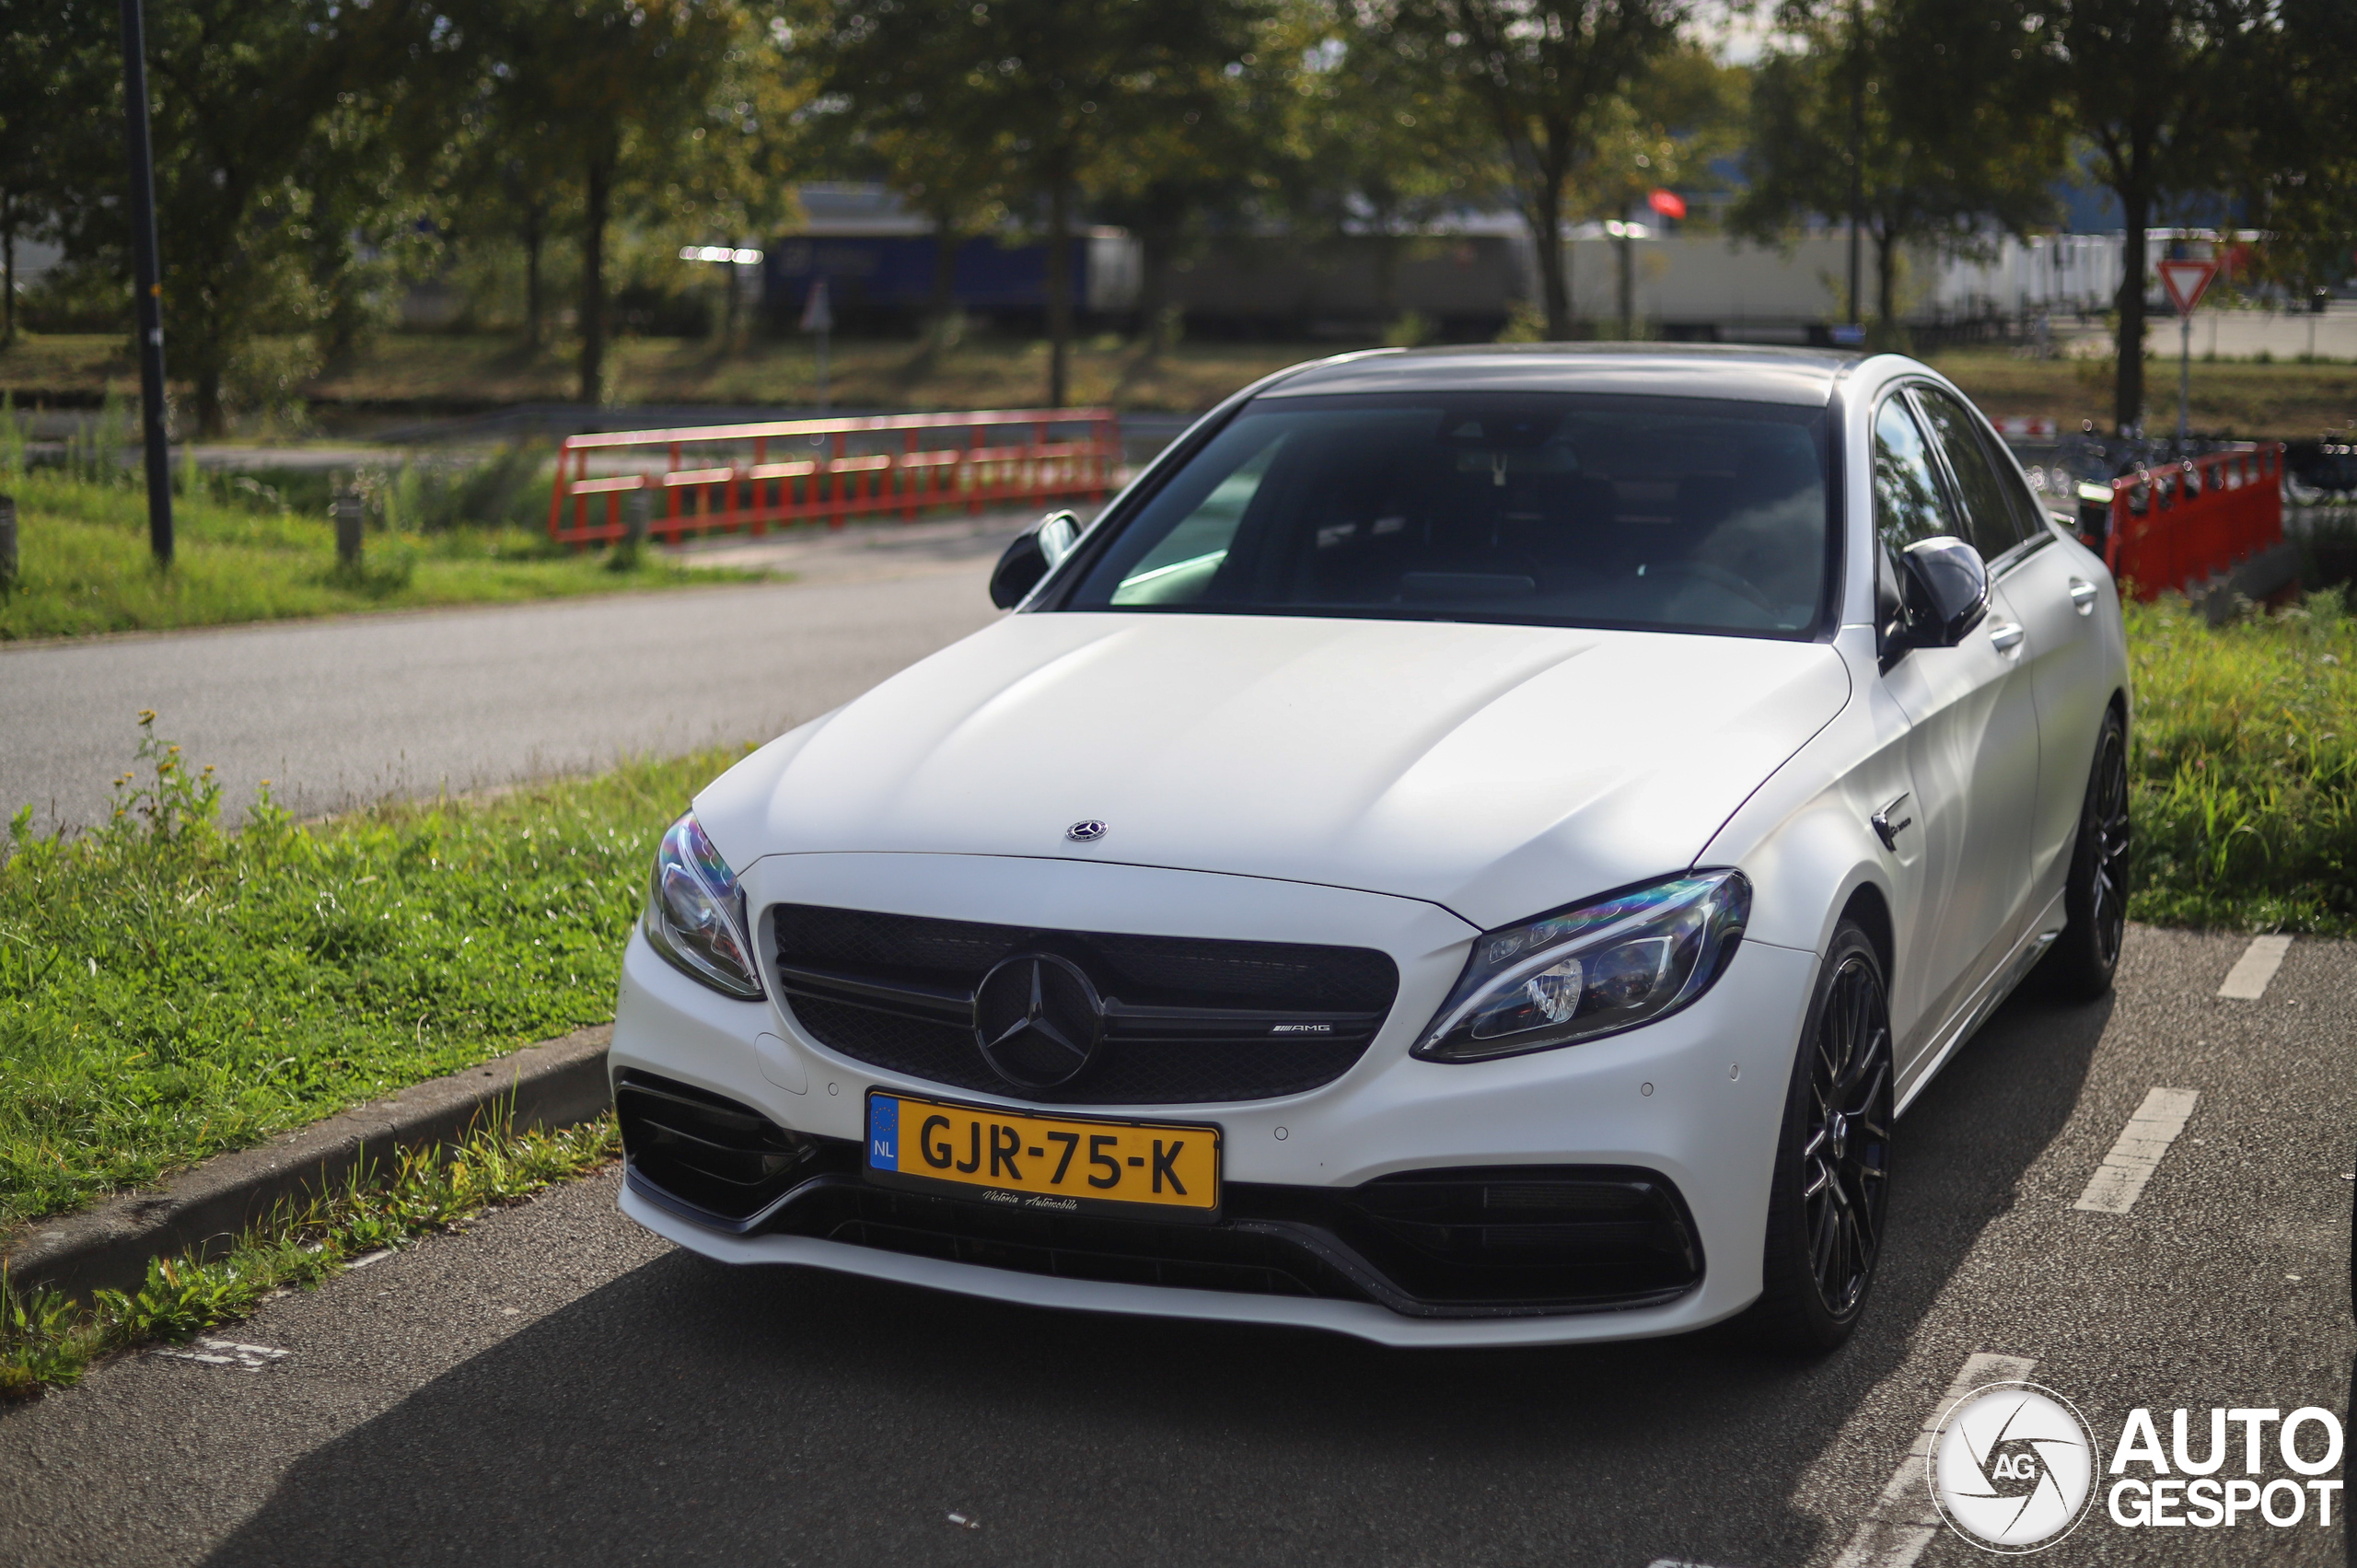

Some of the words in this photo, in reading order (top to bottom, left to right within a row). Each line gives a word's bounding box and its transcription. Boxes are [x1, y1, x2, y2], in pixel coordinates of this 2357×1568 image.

[874, 1140, 894, 1158] NL
[921, 1114, 1188, 1195] GJR-75-K
[982, 1191, 1019, 1203] Victoria
